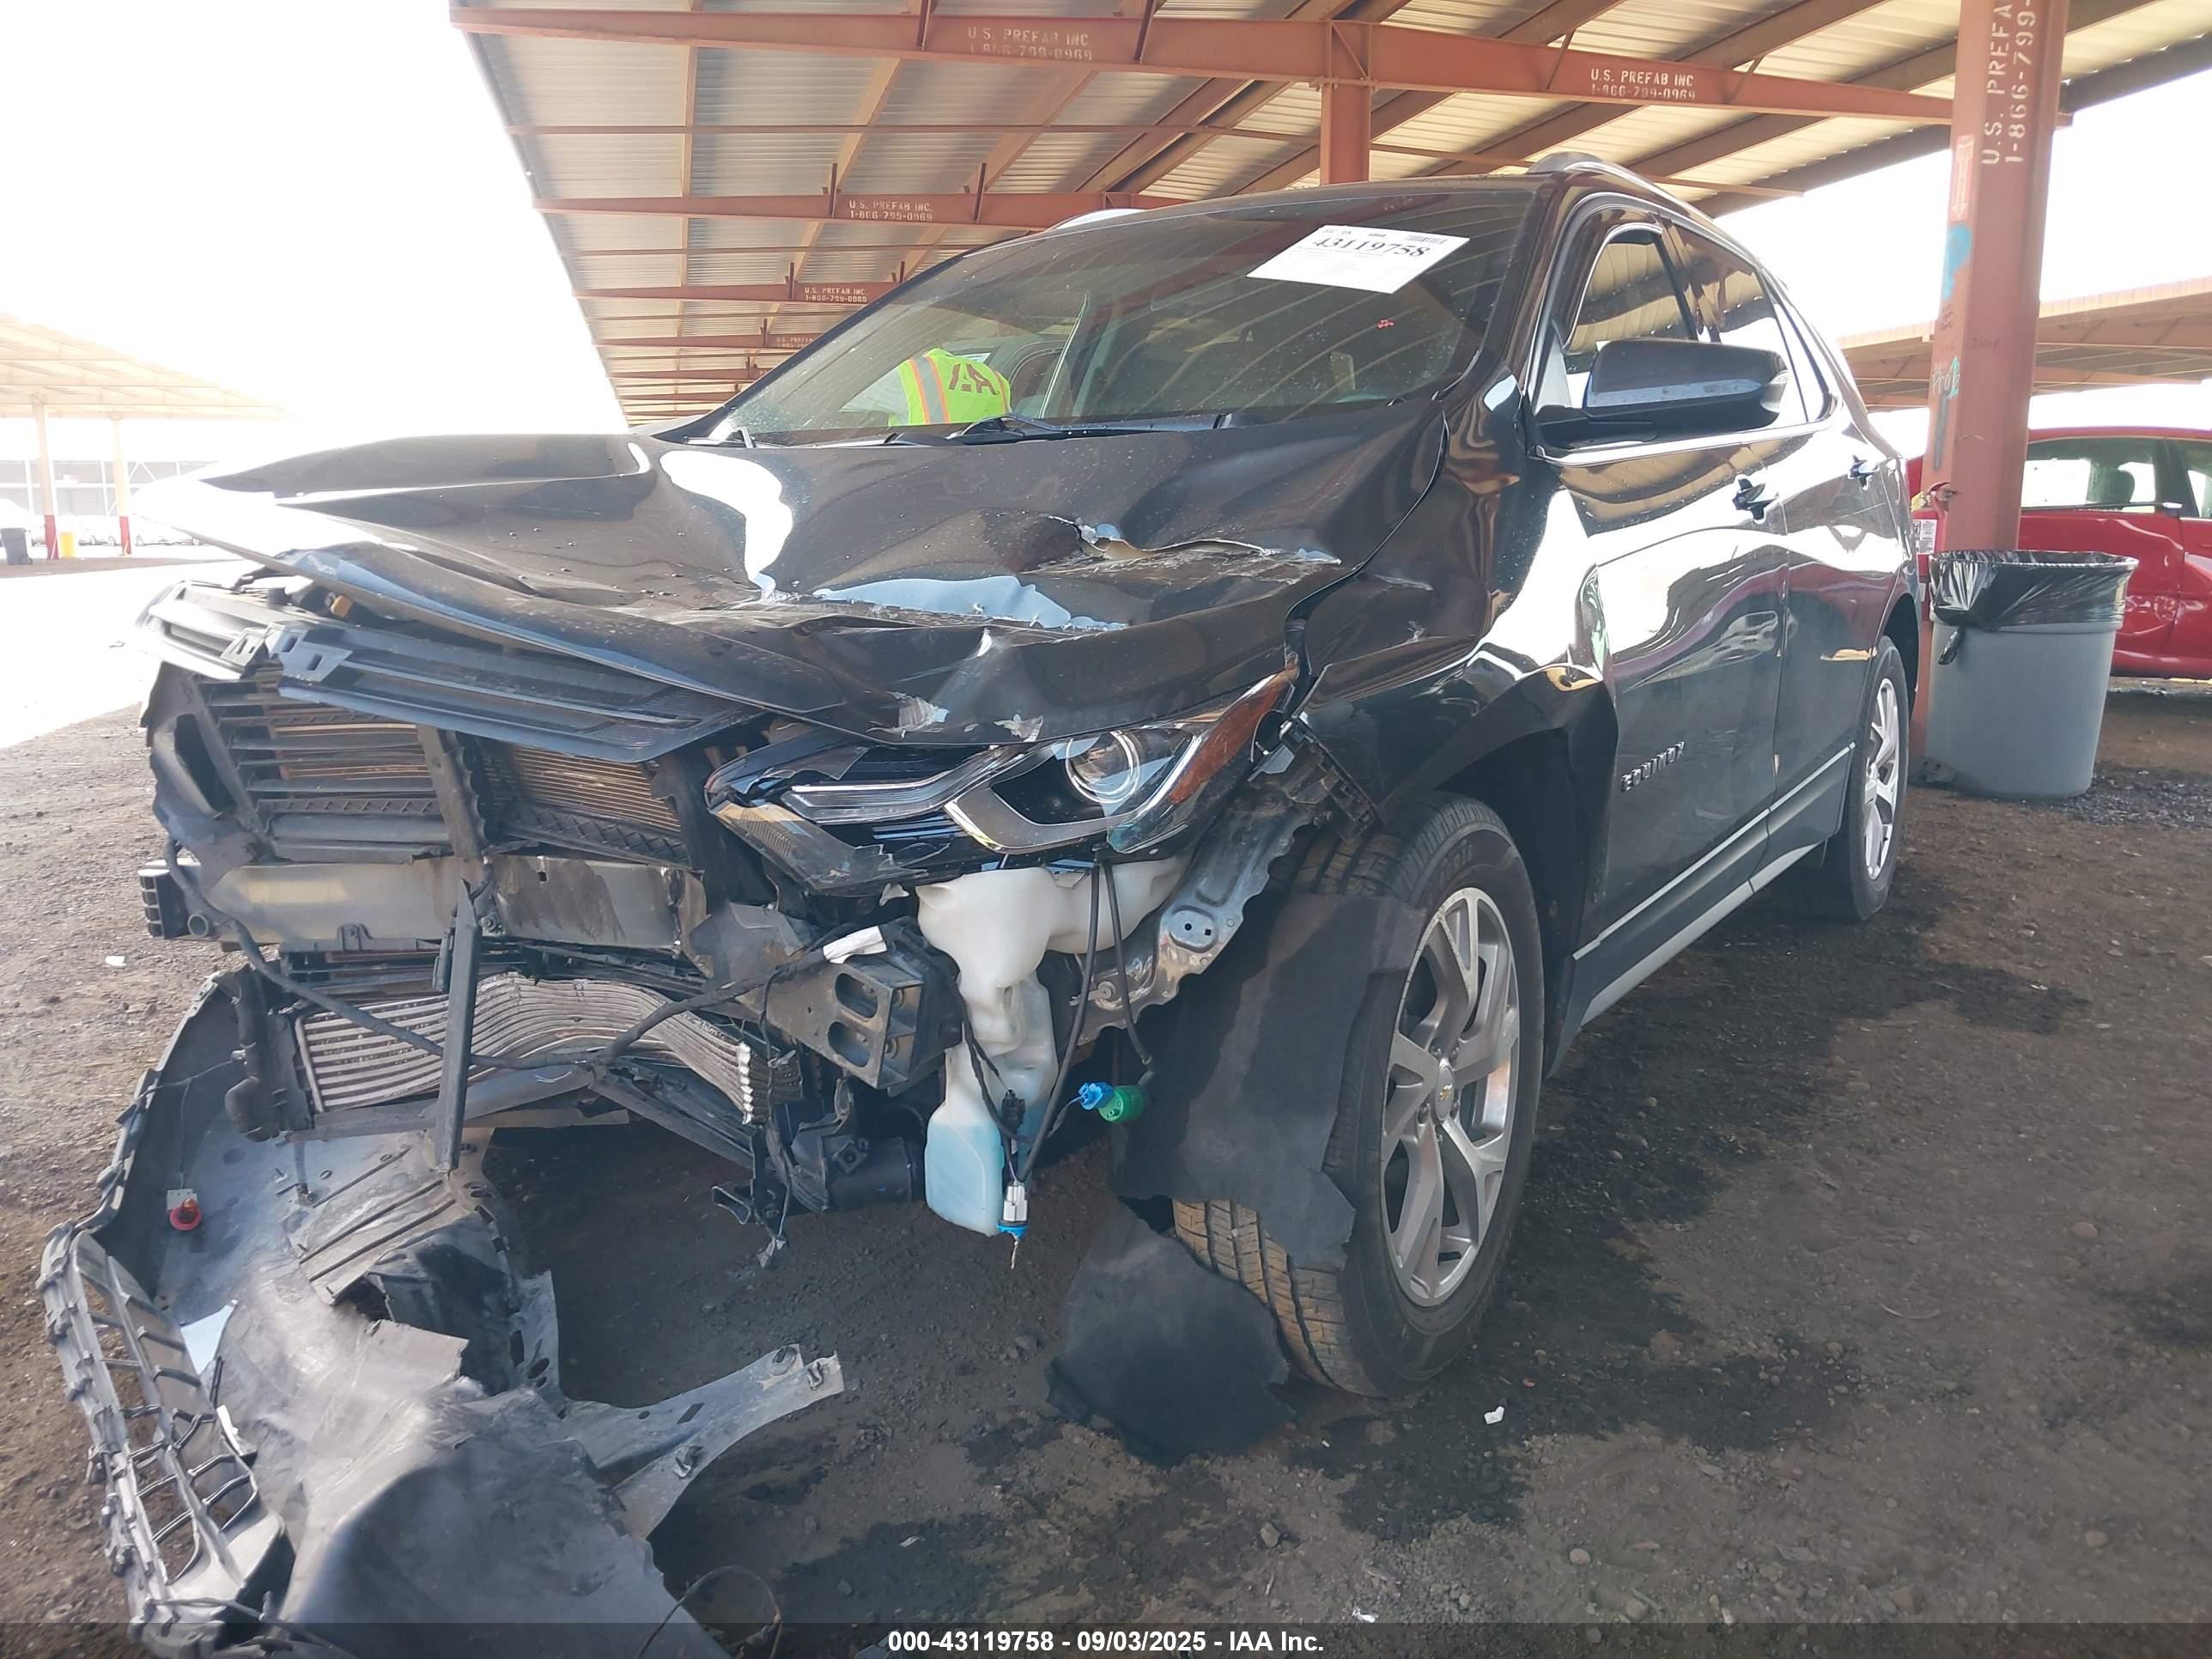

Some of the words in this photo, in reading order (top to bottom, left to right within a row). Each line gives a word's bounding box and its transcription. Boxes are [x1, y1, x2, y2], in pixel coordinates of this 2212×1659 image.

[1003, 28, 1059, 44] PREFAB
[1986, 3, 2014, 95] PREFA
[1590, 68, 1614, 82] U.S.
[1620, 70, 1669, 85] PREFAB
[1674, 74, 1694, 87] INC
[1981, 112, 2004, 165] U.S.
[872, 201, 910, 211] PREFAB
[1312, 237, 1431, 257] 43119758
